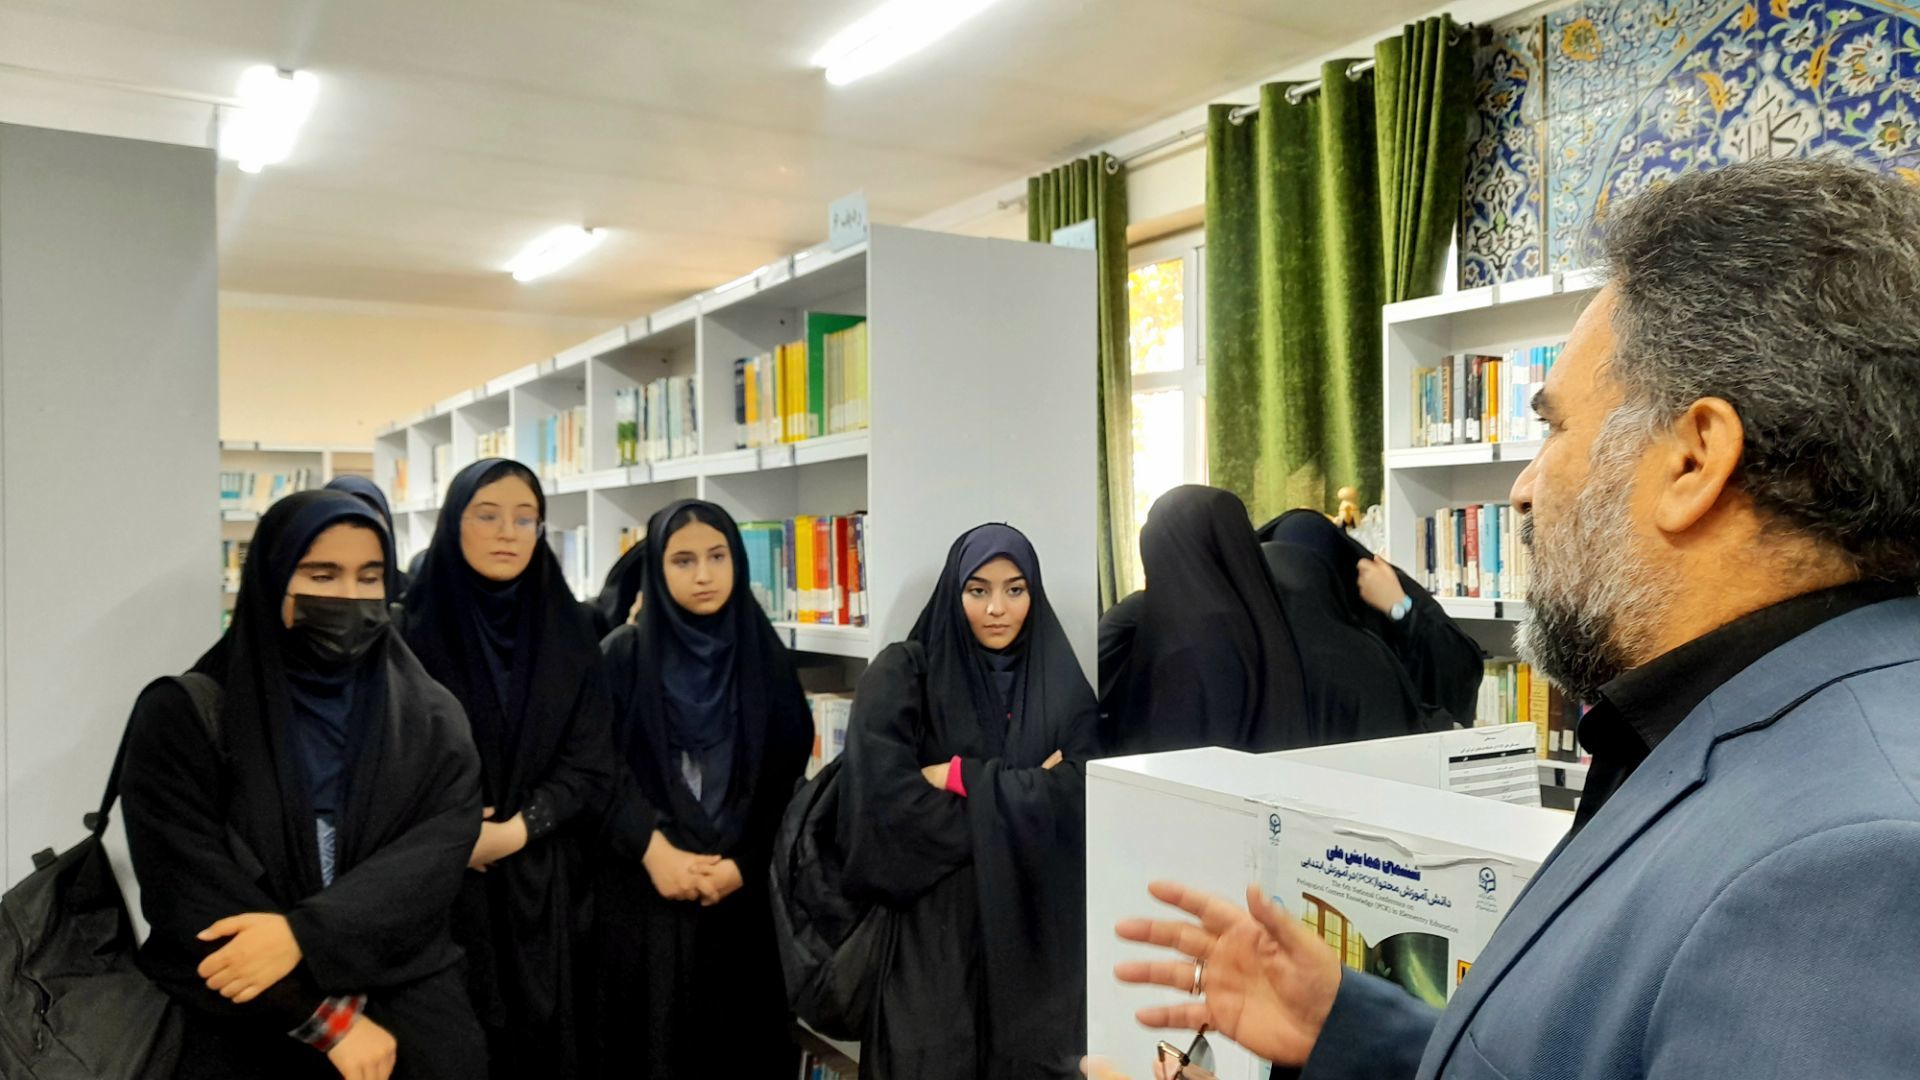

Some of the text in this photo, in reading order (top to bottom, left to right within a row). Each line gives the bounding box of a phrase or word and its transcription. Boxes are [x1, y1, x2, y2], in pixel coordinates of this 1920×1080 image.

[1326, 845, 1344, 862] ملی
[1345, 851, 1380, 870] همایش
[1428, 890, 1452, 908] دانش
